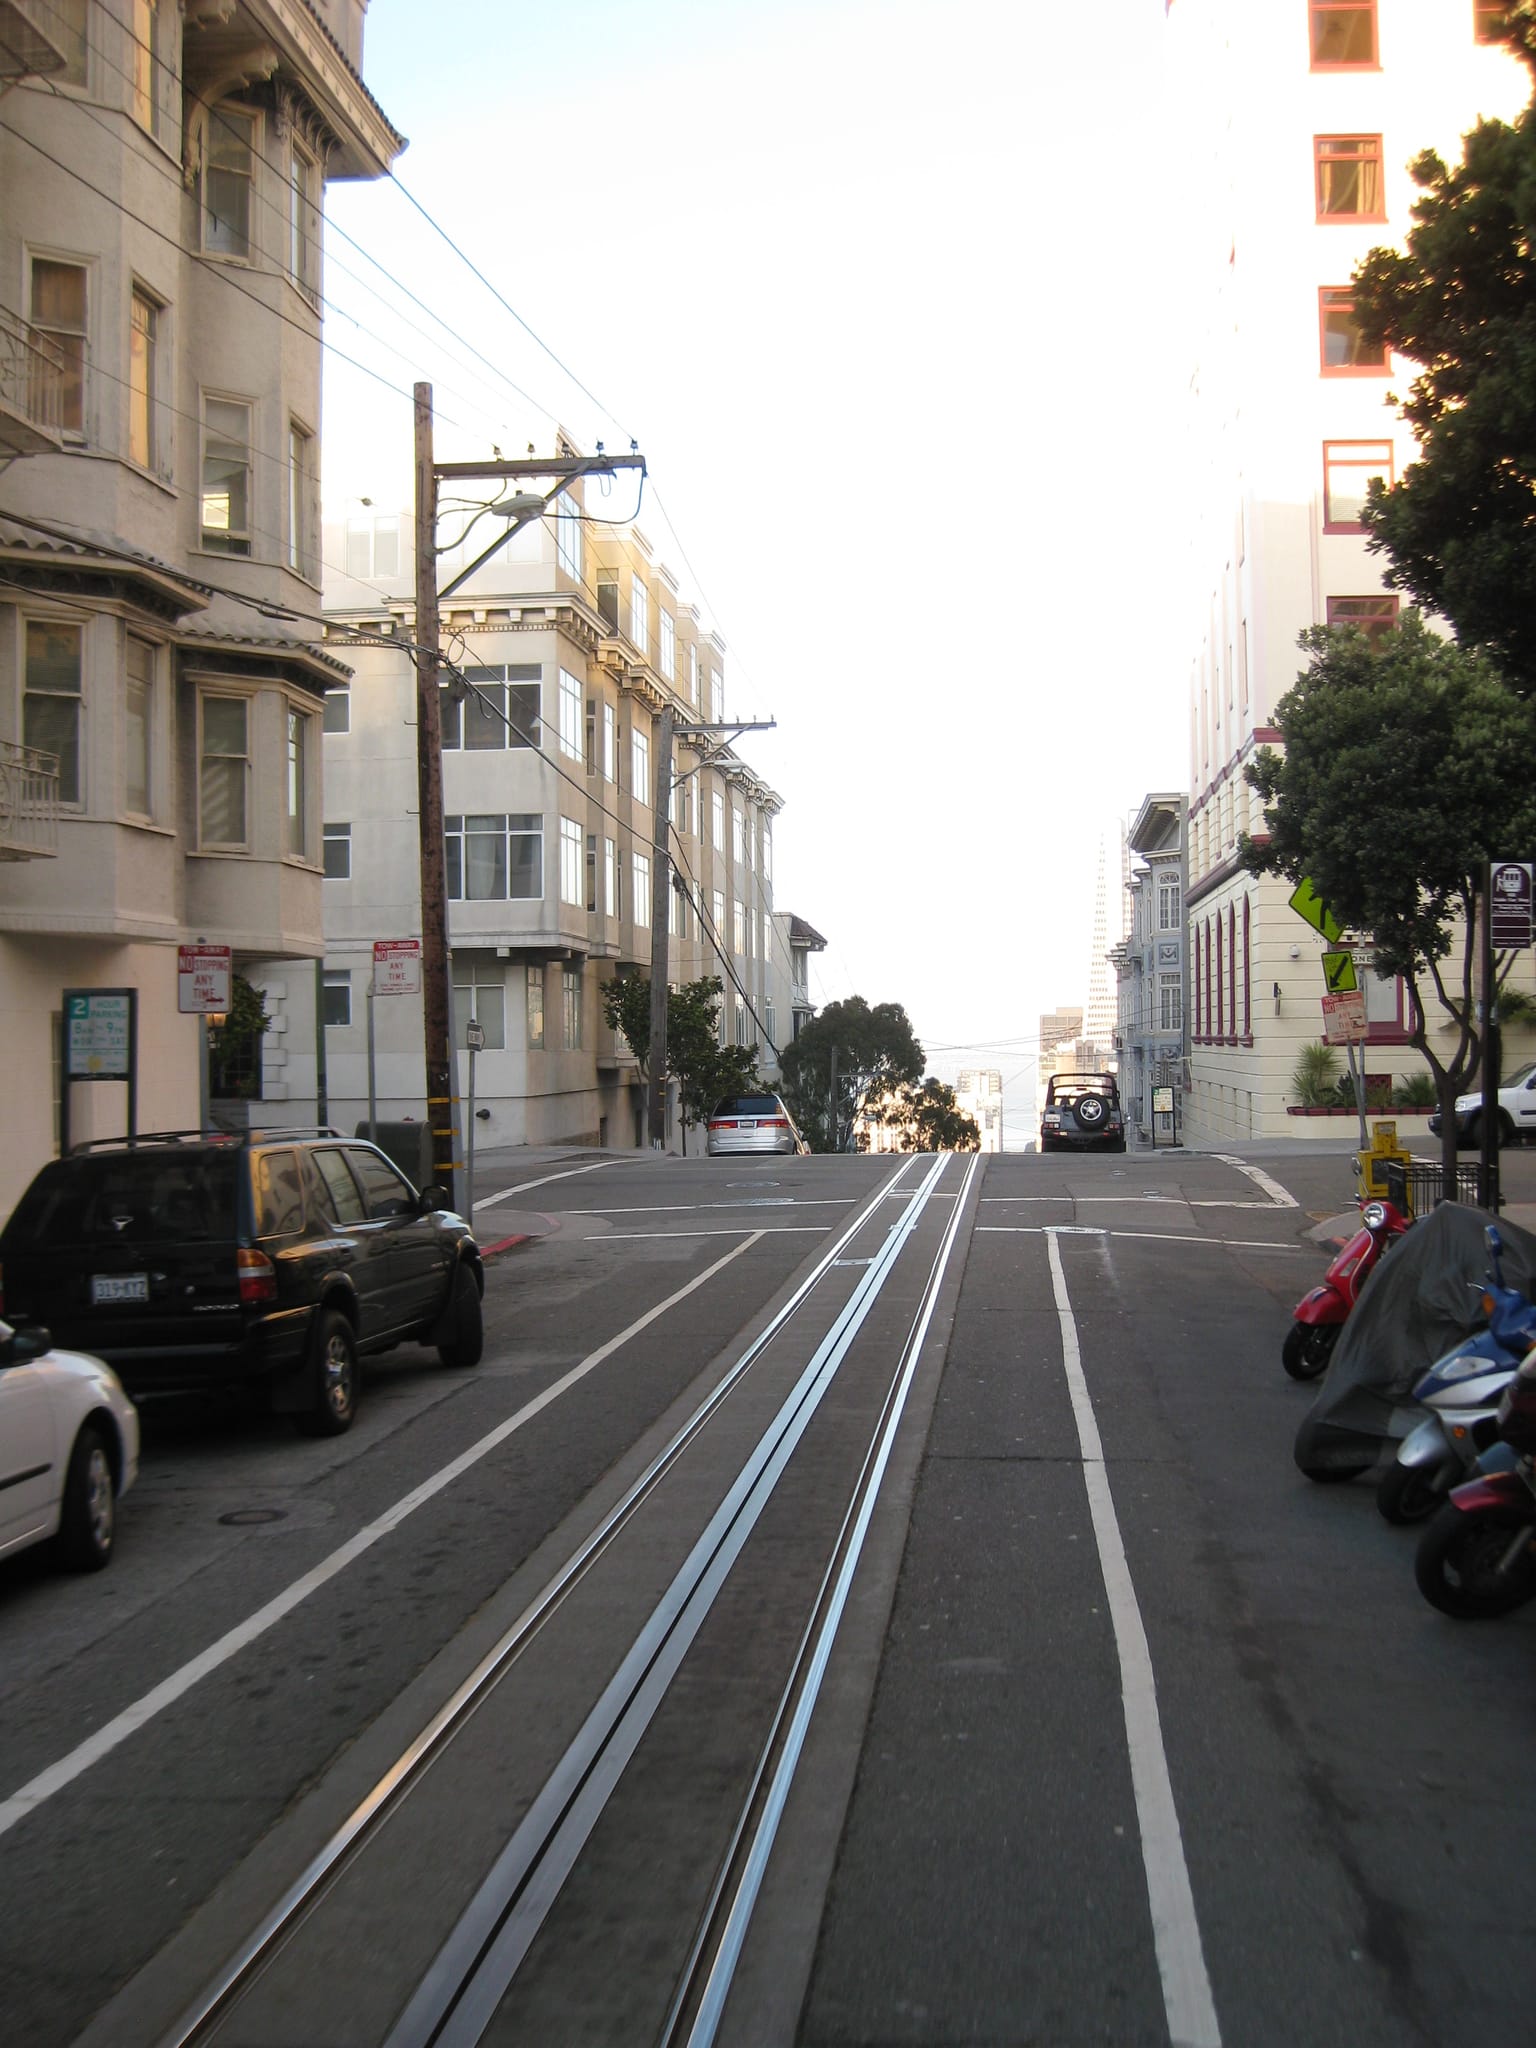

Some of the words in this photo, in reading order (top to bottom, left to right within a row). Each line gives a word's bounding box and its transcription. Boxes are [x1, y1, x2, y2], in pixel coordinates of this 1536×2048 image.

[375, 950, 386, 961] NO
[388, 951, 419, 960] STOPPING
[179, 956, 193, 971] NO
[194, 959, 229, 972] STOPPING
[390, 961, 405, 970] ANY
[194, 974, 214, 986] ANY
[388, 972, 407, 981] TIME
[193, 987, 216, 1000] TIME
[73, 998, 87, 1015] 2
